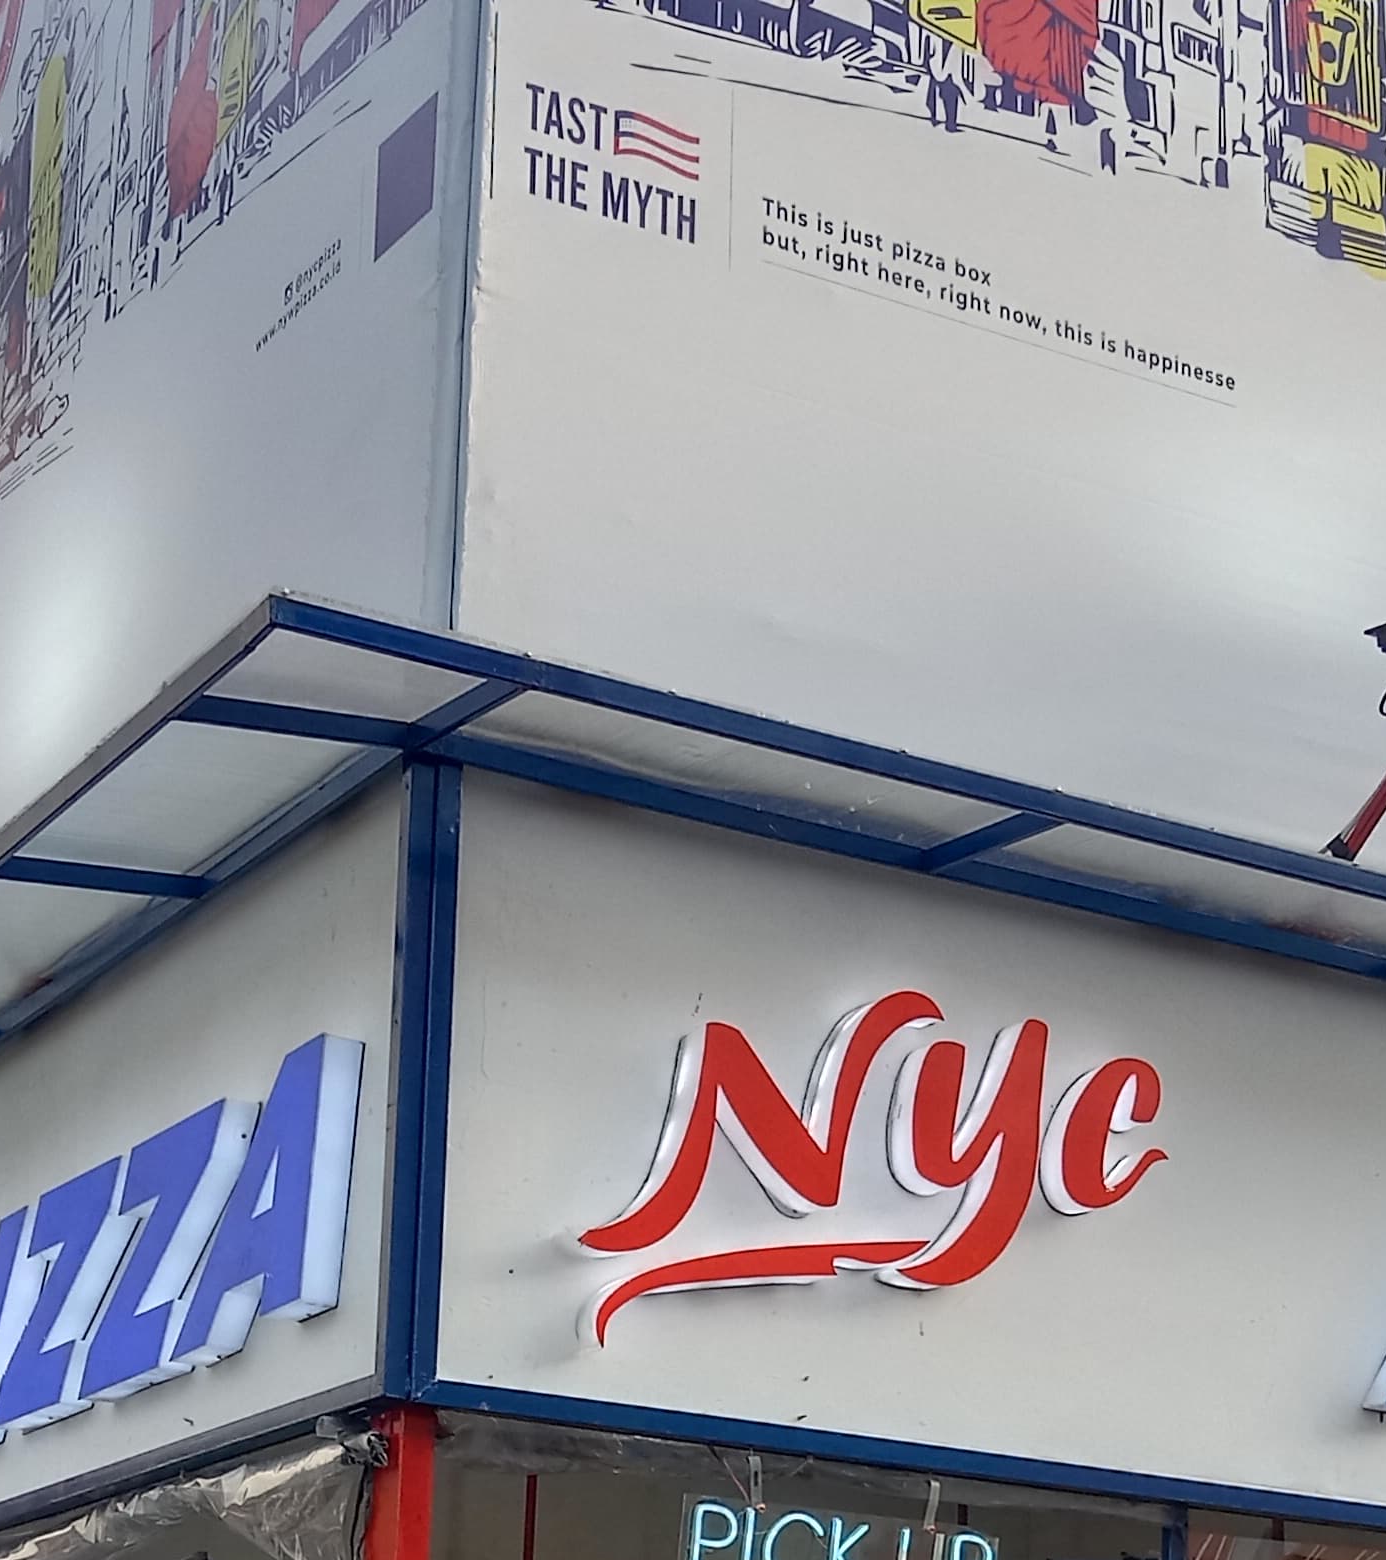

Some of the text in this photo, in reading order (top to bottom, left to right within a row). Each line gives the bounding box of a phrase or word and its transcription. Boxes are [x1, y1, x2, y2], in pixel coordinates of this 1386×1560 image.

[524, 145, 696, 244] THE MYTH
[762, 197, 991, 287] This is just pizza box
[762, 225, 1237, 390] but, right here, right now, this is happinesse
